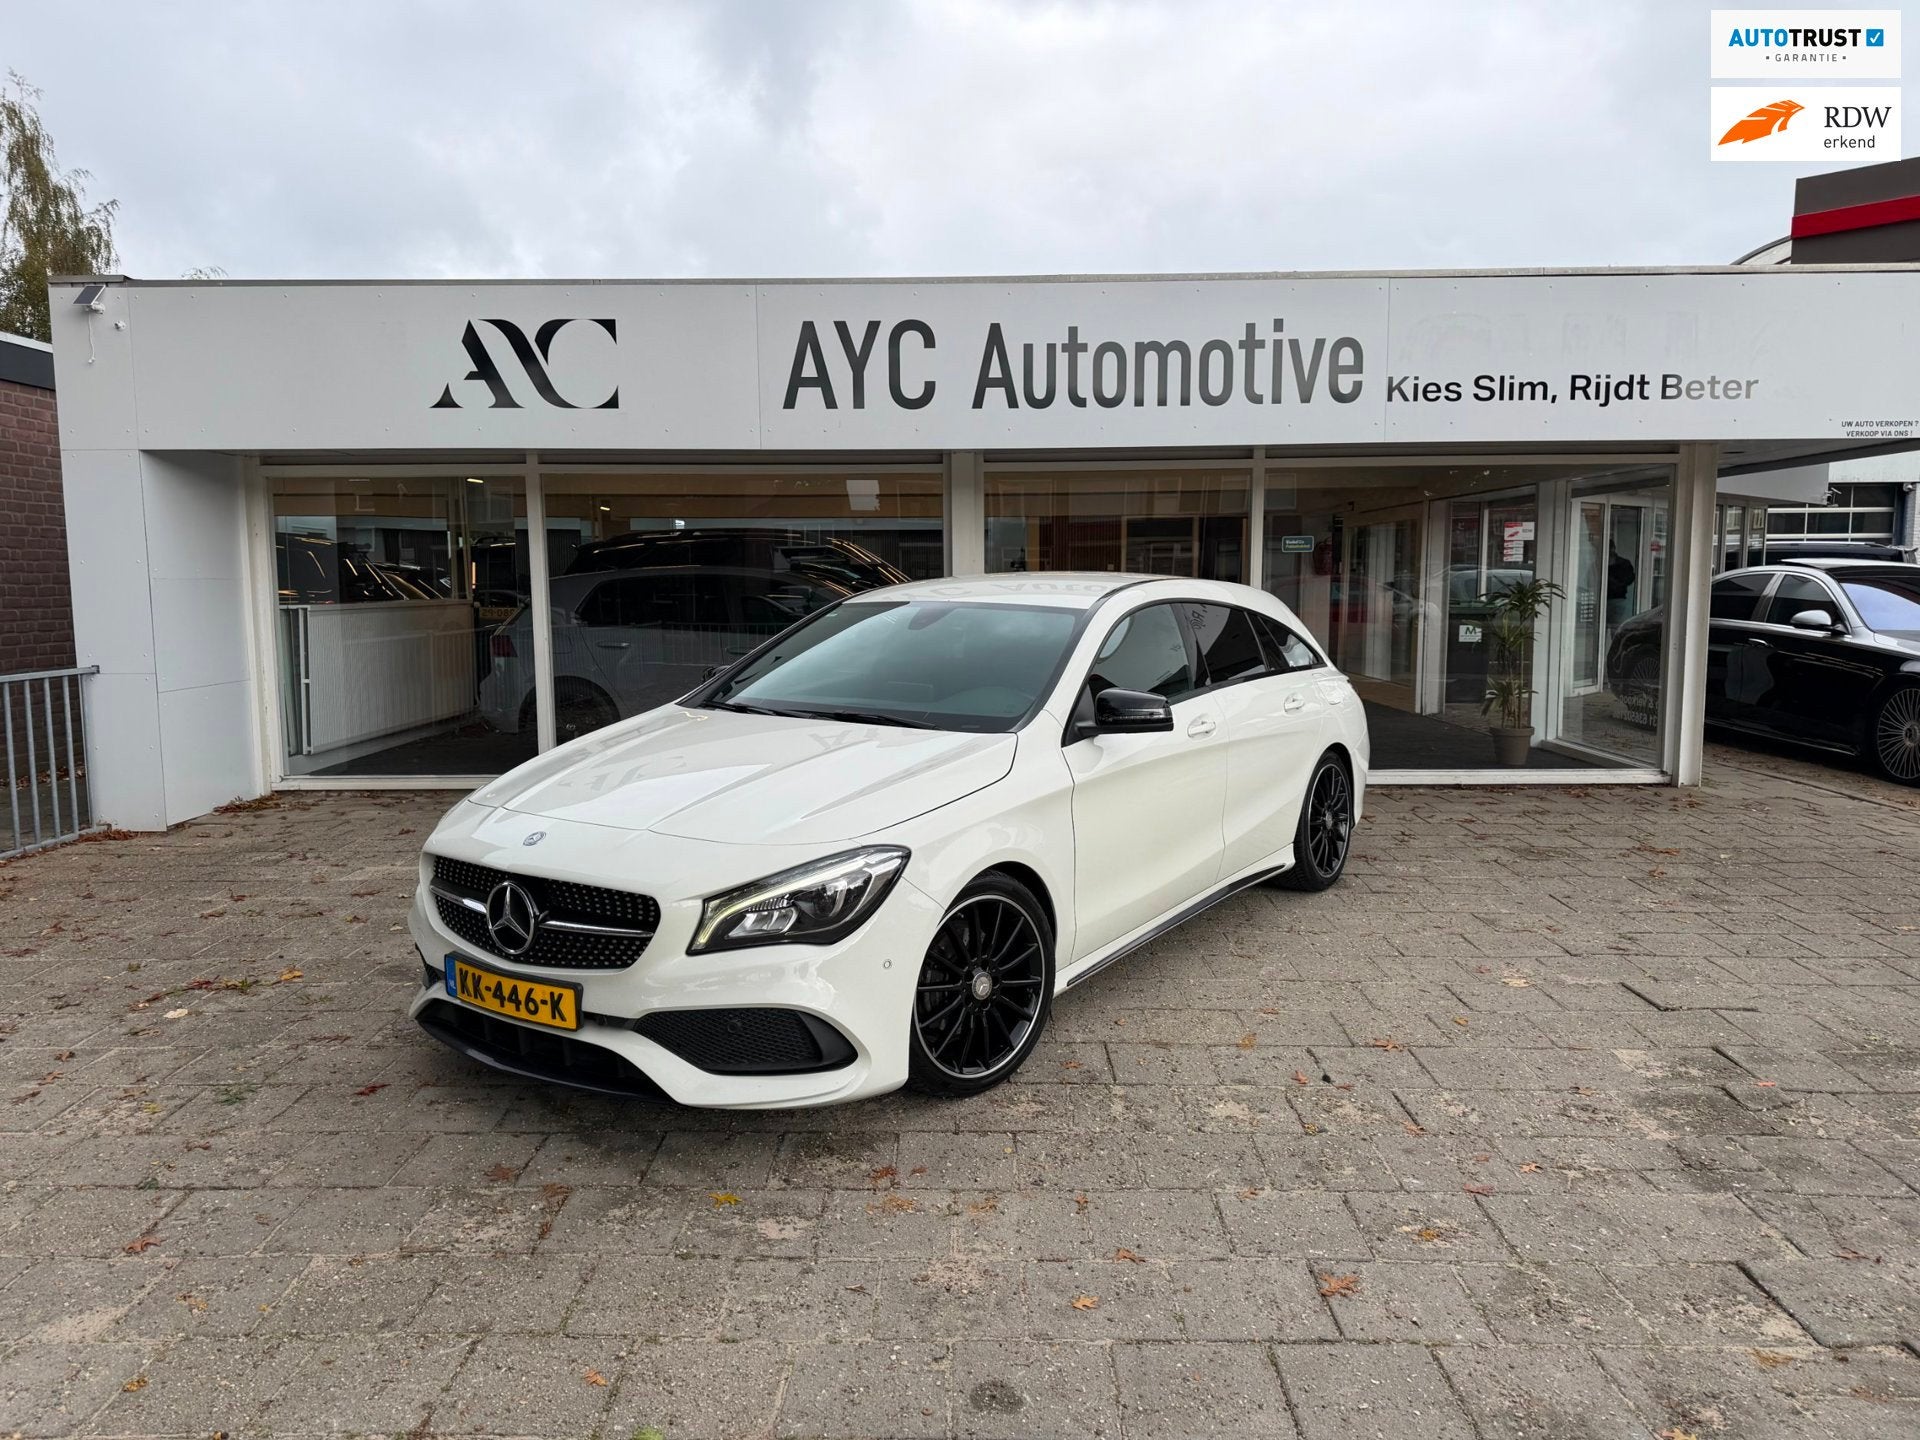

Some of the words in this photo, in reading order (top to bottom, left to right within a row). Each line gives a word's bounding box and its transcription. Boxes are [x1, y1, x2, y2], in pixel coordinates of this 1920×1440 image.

[782, 319, 937, 410] AYC
[971, 318, 1365, 410] Automotive
[1386, 375, 1463, 403] Kies
[1472, 375, 1558, 404] Slim,
[1569, 374, 1651, 408] Rijdt
[1660, 373, 1760, 401] Beter
[458, 967, 568, 1022] KK-446-K
